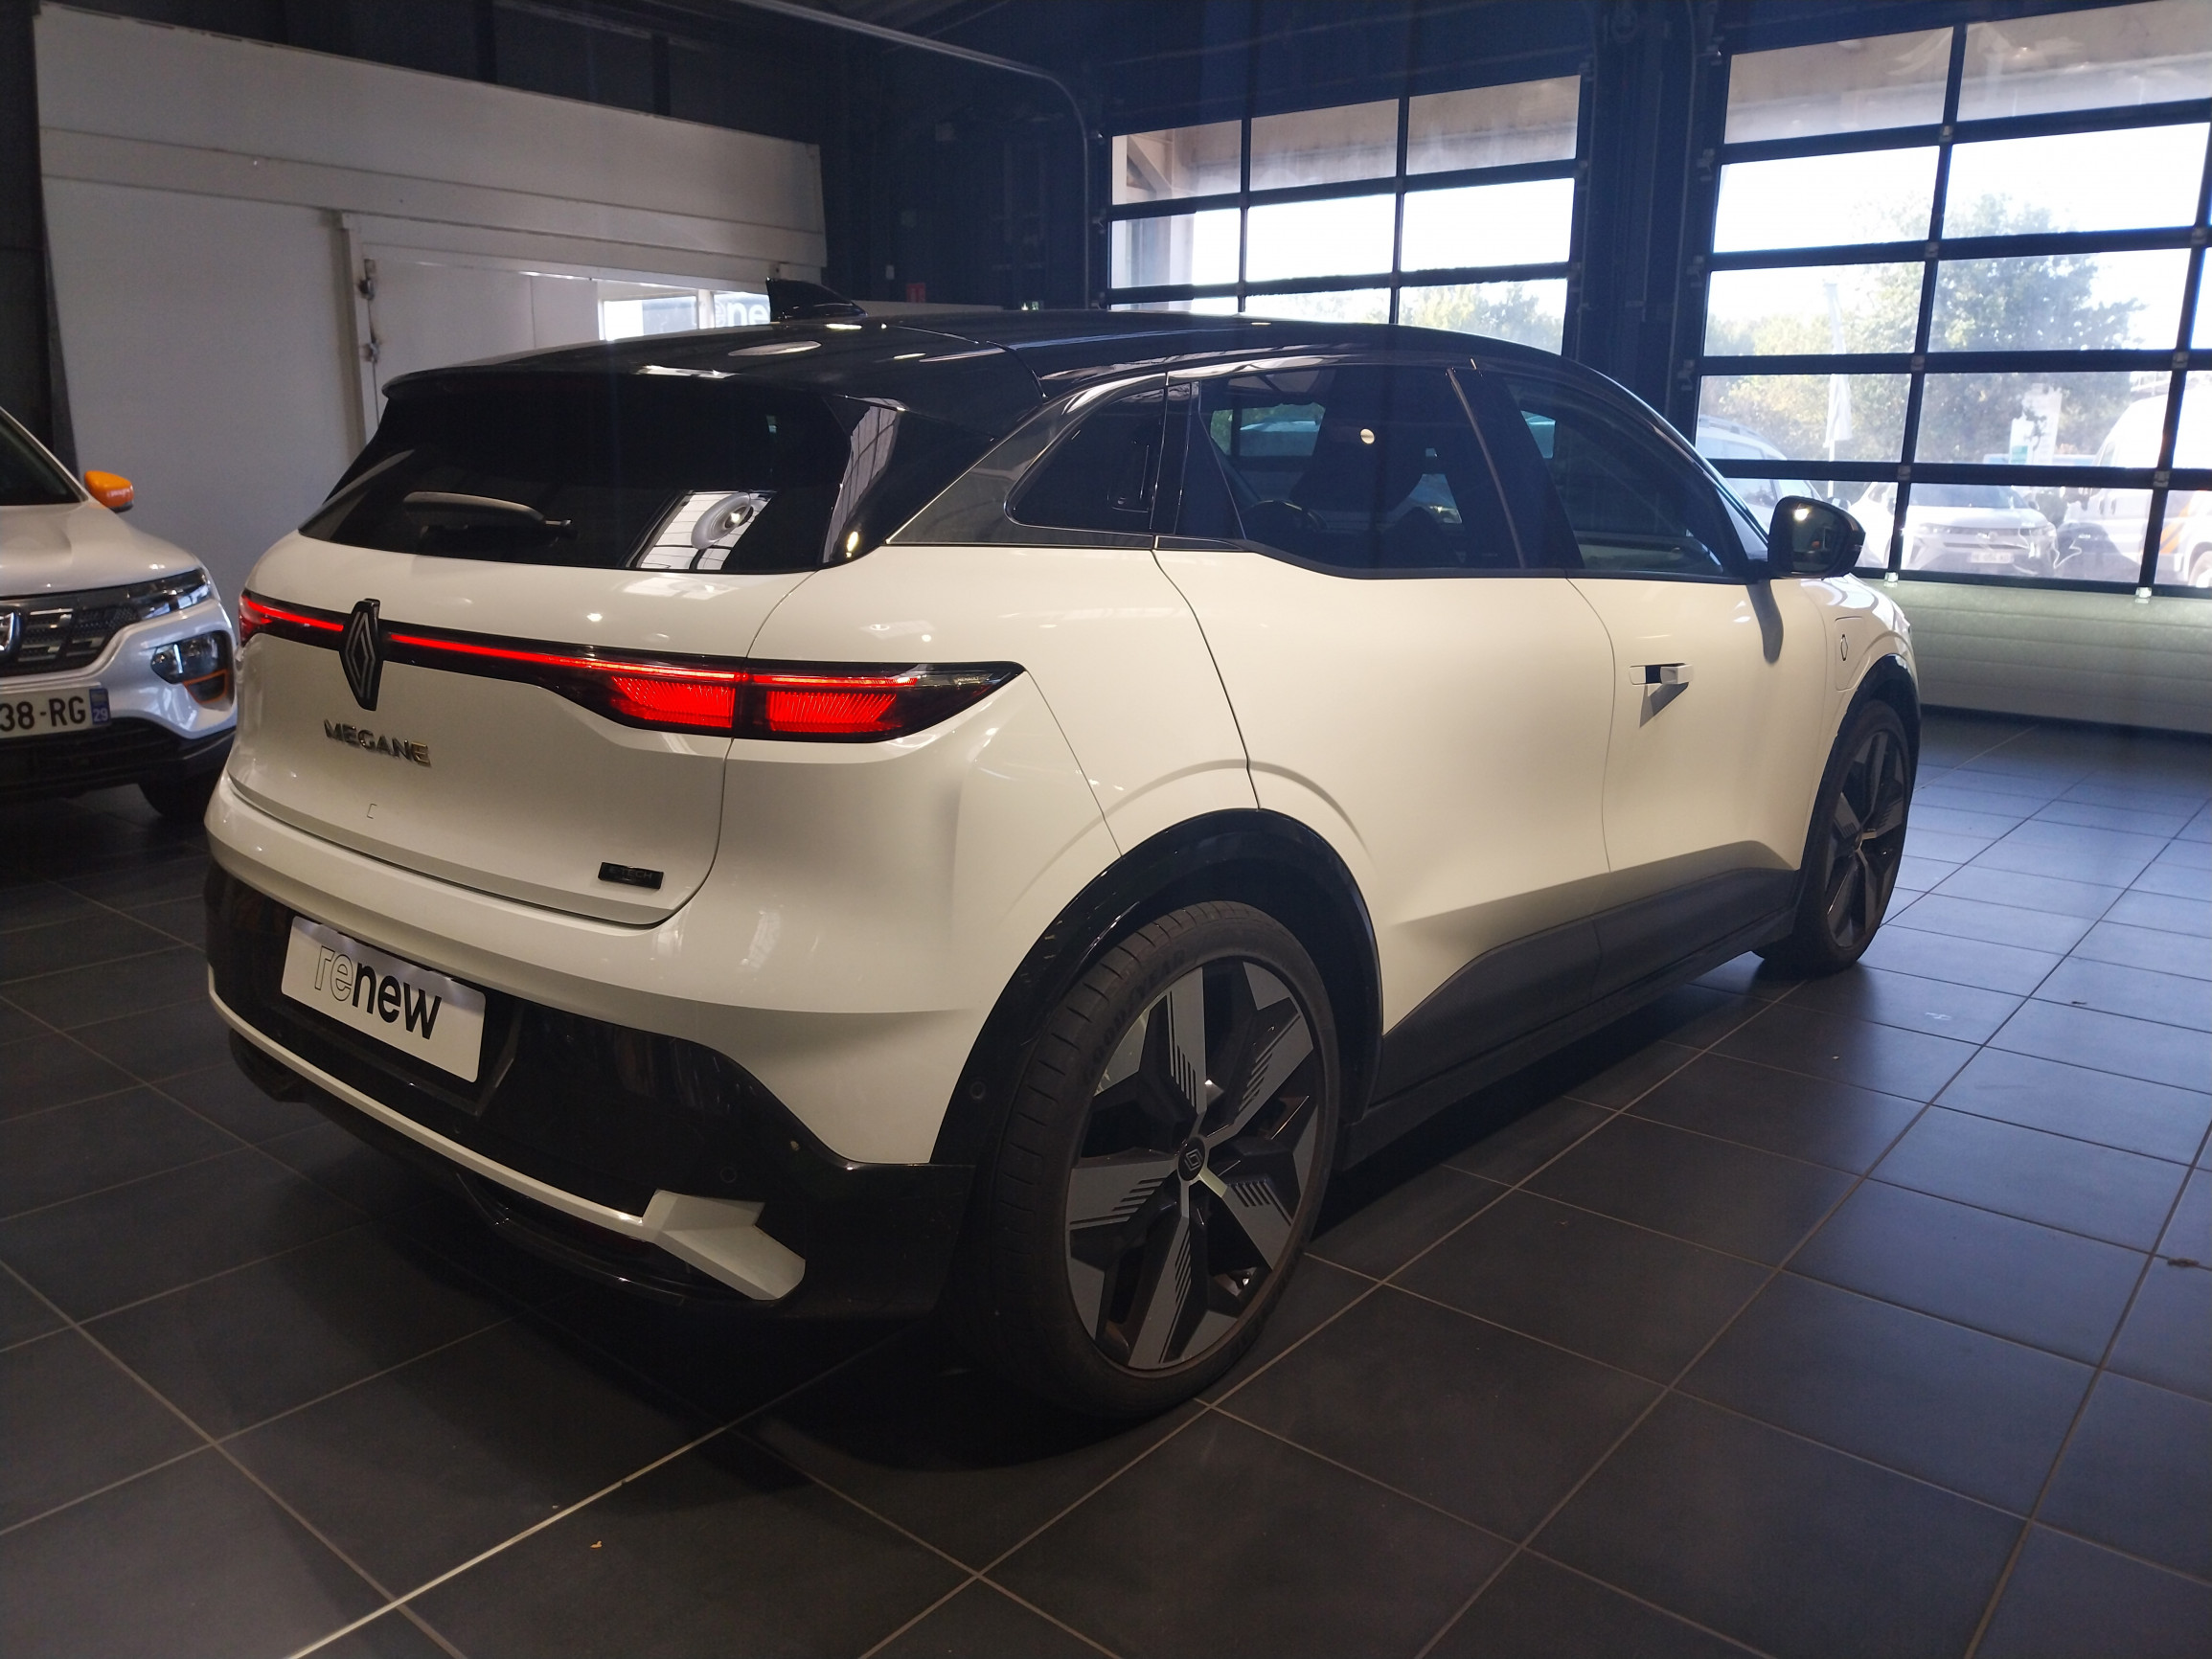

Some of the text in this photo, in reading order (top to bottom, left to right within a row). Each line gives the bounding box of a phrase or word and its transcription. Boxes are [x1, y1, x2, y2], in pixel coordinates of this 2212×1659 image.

[0, 695, 86, 732] 38-RG
[92, 708, 109, 722] 29
[324, 717, 432, 767] MEGANE
[314, 944, 443, 1041] renew
